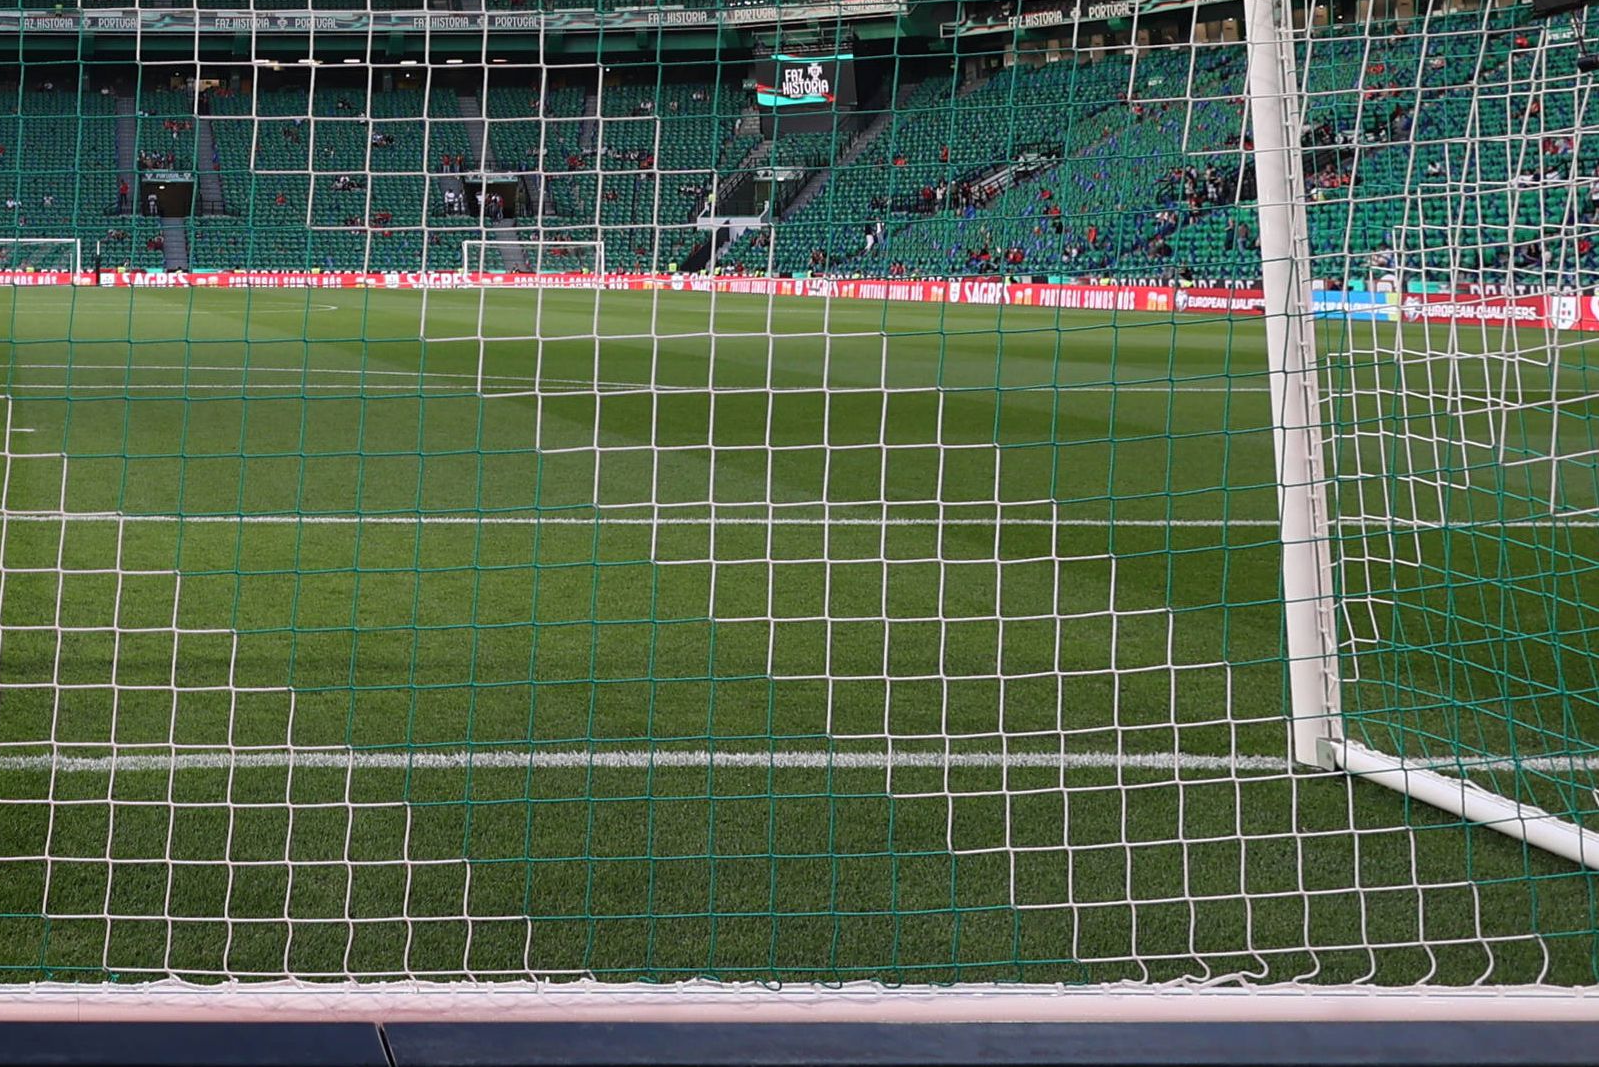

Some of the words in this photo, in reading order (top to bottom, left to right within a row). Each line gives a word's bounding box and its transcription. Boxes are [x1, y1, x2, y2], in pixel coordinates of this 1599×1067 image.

[1088, 2, 1132, 19] PORTUGAL
[19, 17, 34, 29] AZ
[98, 17, 139, 28] PORTUGA
[495, 16, 539, 28] PORTUGAL
[784, 68, 805, 83] FAZ
[782, 77, 830, 95] HISTÓRIA
[122, 272, 189, 287] SAGRES
[228, 276, 279, 288] PORTUGAL
[406, 273, 473, 288] SAGRES
[964, 281, 1011, 305] SAGRES
[1039, 288, 1082, 309] PORTUGAL
[1083, 290, 1114, 310] SOMOS
[1116, 286, 1136, 310] NÓS
[1188, 296, 1228, 309] EUROPEAN
